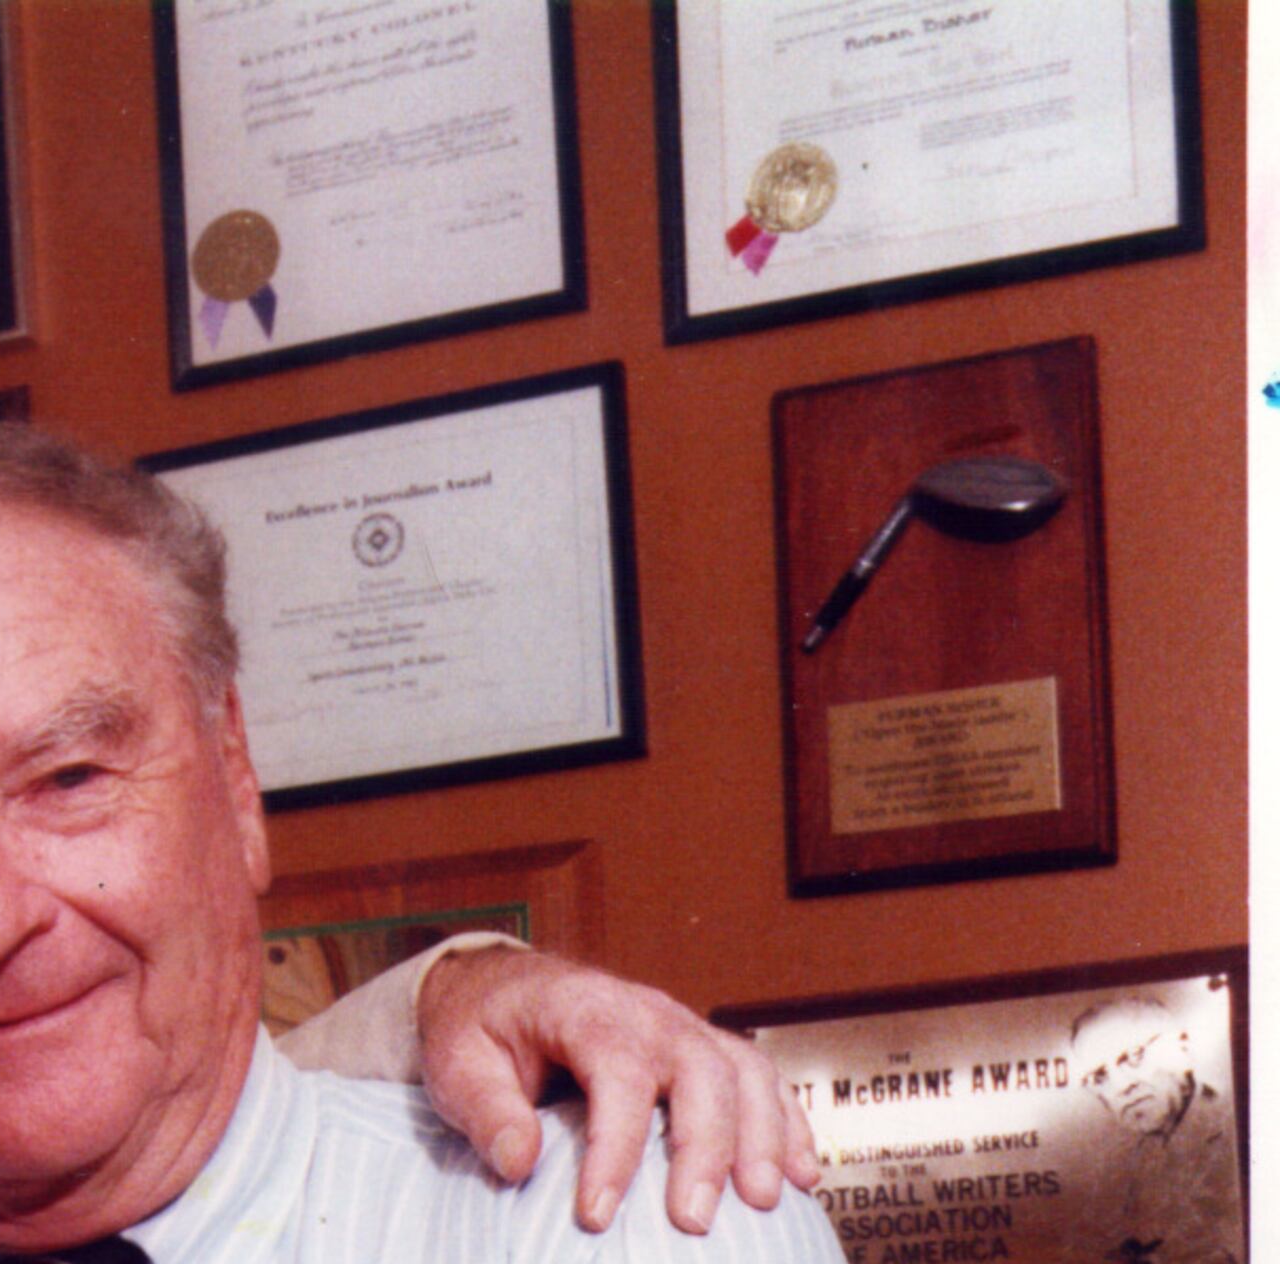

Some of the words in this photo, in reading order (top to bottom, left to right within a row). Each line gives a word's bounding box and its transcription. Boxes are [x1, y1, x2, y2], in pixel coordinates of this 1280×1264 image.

[266, 502, 337, 523] Excellence
[342, 497, 357, 511] in
[362, 484, 440, 508] Journalism
[446, 470, 493, 490] Award
[889, 1051, 911, 1066] THE
[833, 1068, 953, 1108] McGRANE
[972, 1057, 1069, 1094] AWARD
[840, 1138, 965, 1165] DISTINGUISHED
[973, 1130, 1040, 1154] SERVICE
[880, 1166, 897, 1179] TO
[903, 1163, 927, 1177] THE
[815, 1181, 924, 1212] OTBALL
[933, 1170, 1062, 1200] WRITERS
[841, 1204, 1013, 1241] SSOCIATION
